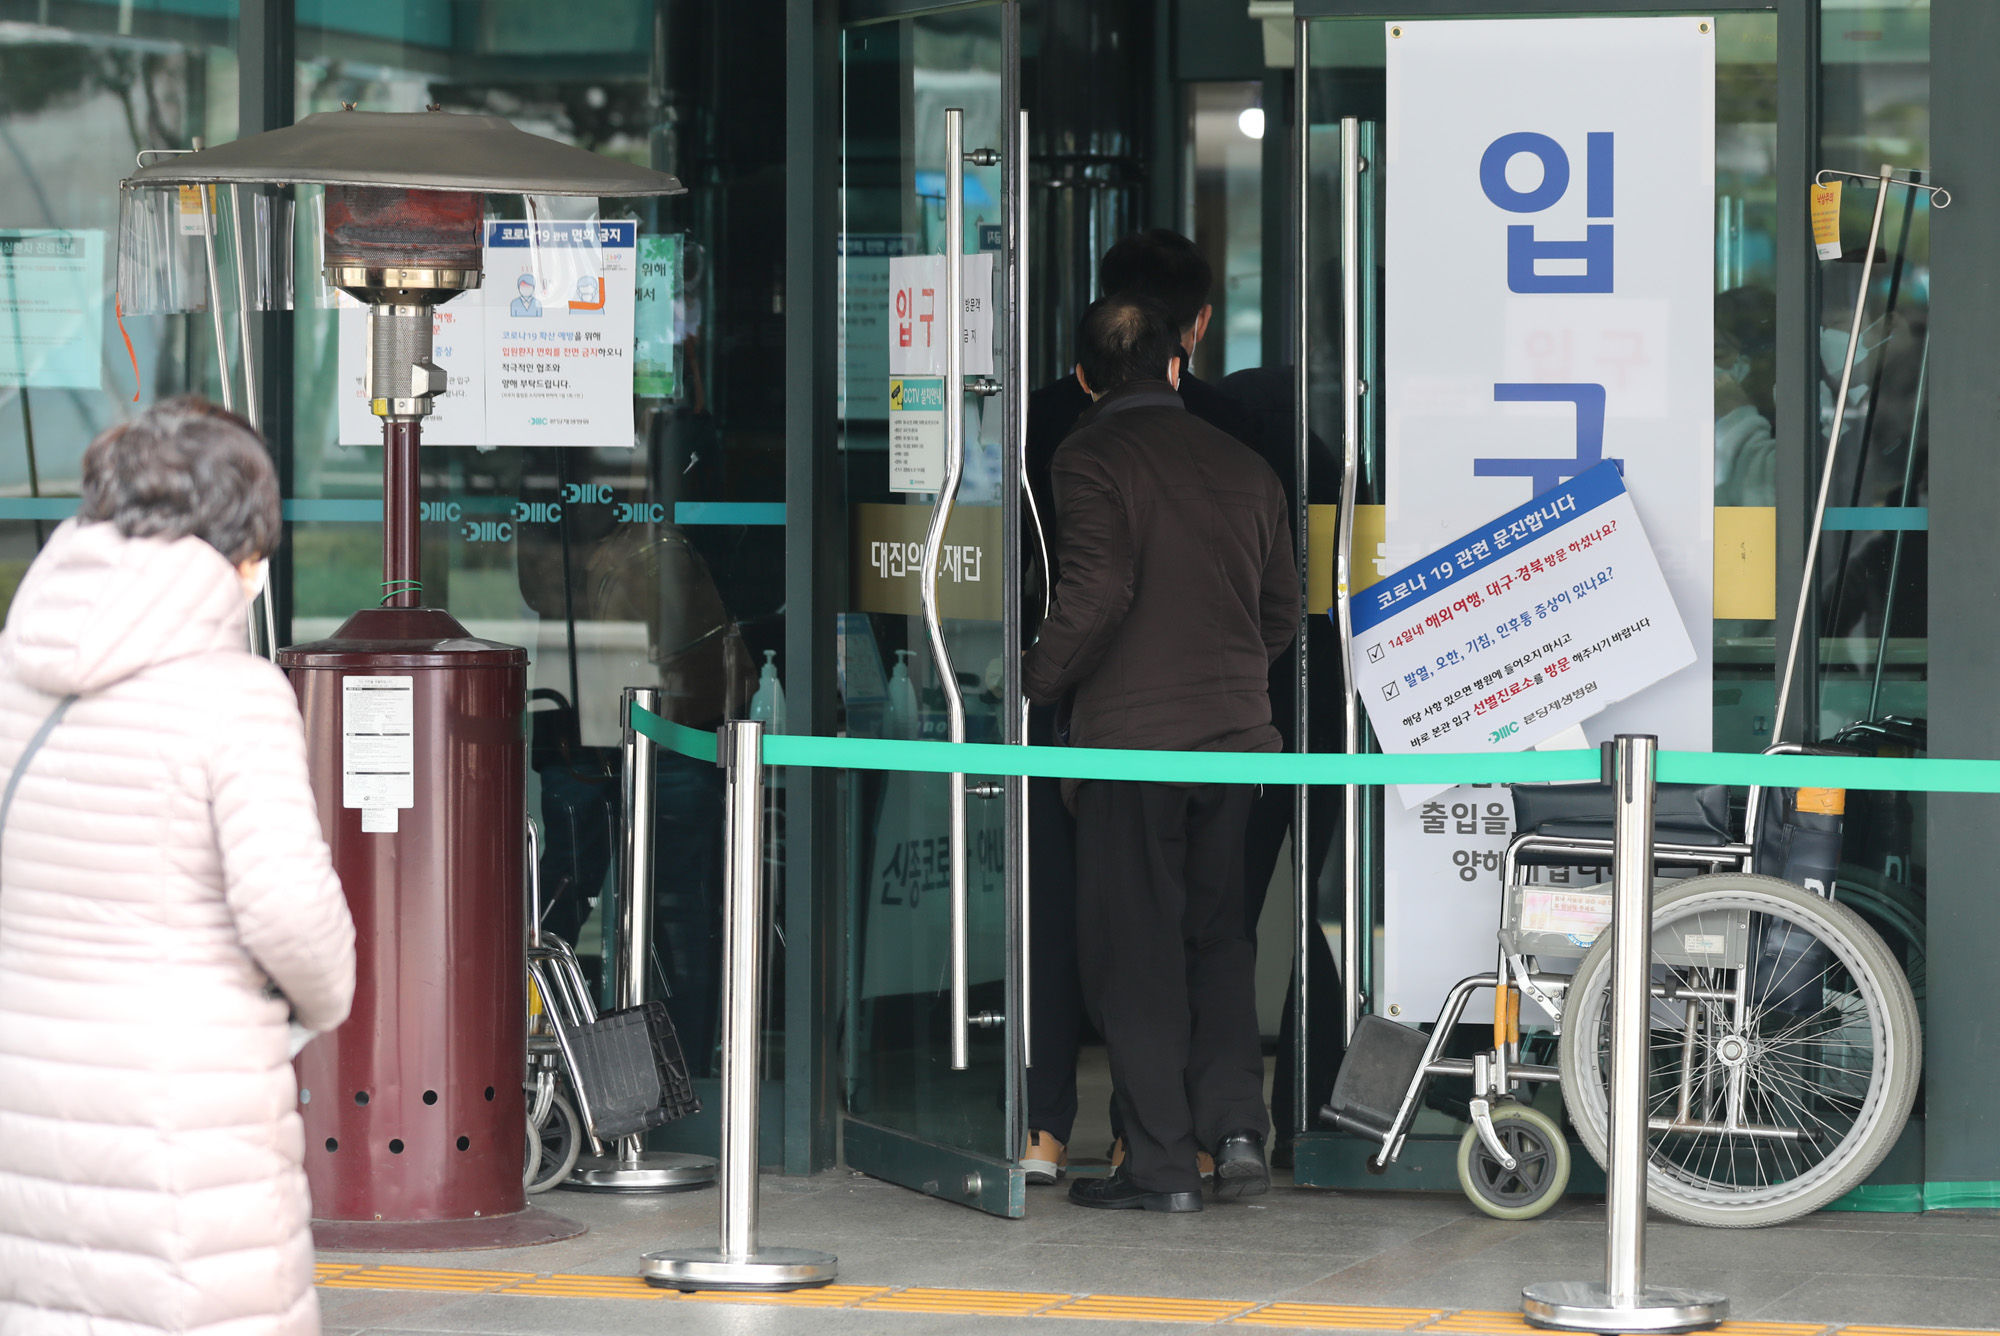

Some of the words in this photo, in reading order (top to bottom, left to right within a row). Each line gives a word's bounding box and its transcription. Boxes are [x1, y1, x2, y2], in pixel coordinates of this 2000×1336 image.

[572, 228, 594, 242] 면회
[598, 228, 621, 242] 금지
[641, 262, 666, 277] 위해
[502, 331, 537, 341] 코로나19
[584, 331, 602, 342] 위해
[896, 287, 934, 348] 입구
[502, 347, 534, 358] 입원환자
[536, 347, 561, 358] 면회를
[563, 347, 580, 358] 전면
[581, 347, 622, 358] 금지하오니
[502, 363, 534, 374] 적극적인
[536, 363, 561, 374] 협조와
[501, 379, 518, 390] 양해
[520, 379, 571, 390] 부탁드립니다.
[903, 387, 920, 404] CCTV
[872, 539, 980, 583] 대진의재단
[1377, 575, 1426, 610] 코로나
[1431, 562, 1453, 580] 19
[1455, 539, 1491, 570] 관련
[1493, 493, 1576, 550] 문진합니다
[1388, 623, 1425, 648] 14일내
[1425, 590, 1485, 630] 해외여행,
[1544, 548, 1567, 567] 방문
[1568, 519, 1618, 553] 하셨나요?
[1403, 664, 1434, 689] 발열,
[1436, 646, 1465, 670] 오한,
[1466, 629, 1496, 654] 기침,
[1496, 609, 1533, 639] 인후통
[1535, 590, 1572, 618] 증상이
[1573, 566, 1615, 599] 있나요?
[1402, 711, 1422, 727] 해당
[1424, 701, 1443, 717] 사항
[1443, 686, 1472, 707] 있으면
[1473, 670, 1504, 691] 병원에
[1504, 648, 1542, 675] 들어오지
[1543, 633, 1573, 654] 마시고
[1410, 732, 1431, 748] 바로
[1432, 723, 1451, 738] 본관
[1452, 711, 1472, 728] 입구
[1472, 672, 1544, 716] 선별진료소를
[1544, 657, 1571, 679] 방문
[1572, 637, 1612, 663] 해주시기
[1612, 617, 1651, 643] 바랍니다
[1523, 681, 1598, 725] 분당제생병원
[1420, 802, 1510, 835] 출입을
[881, 836, 971, 908] 신종코로
